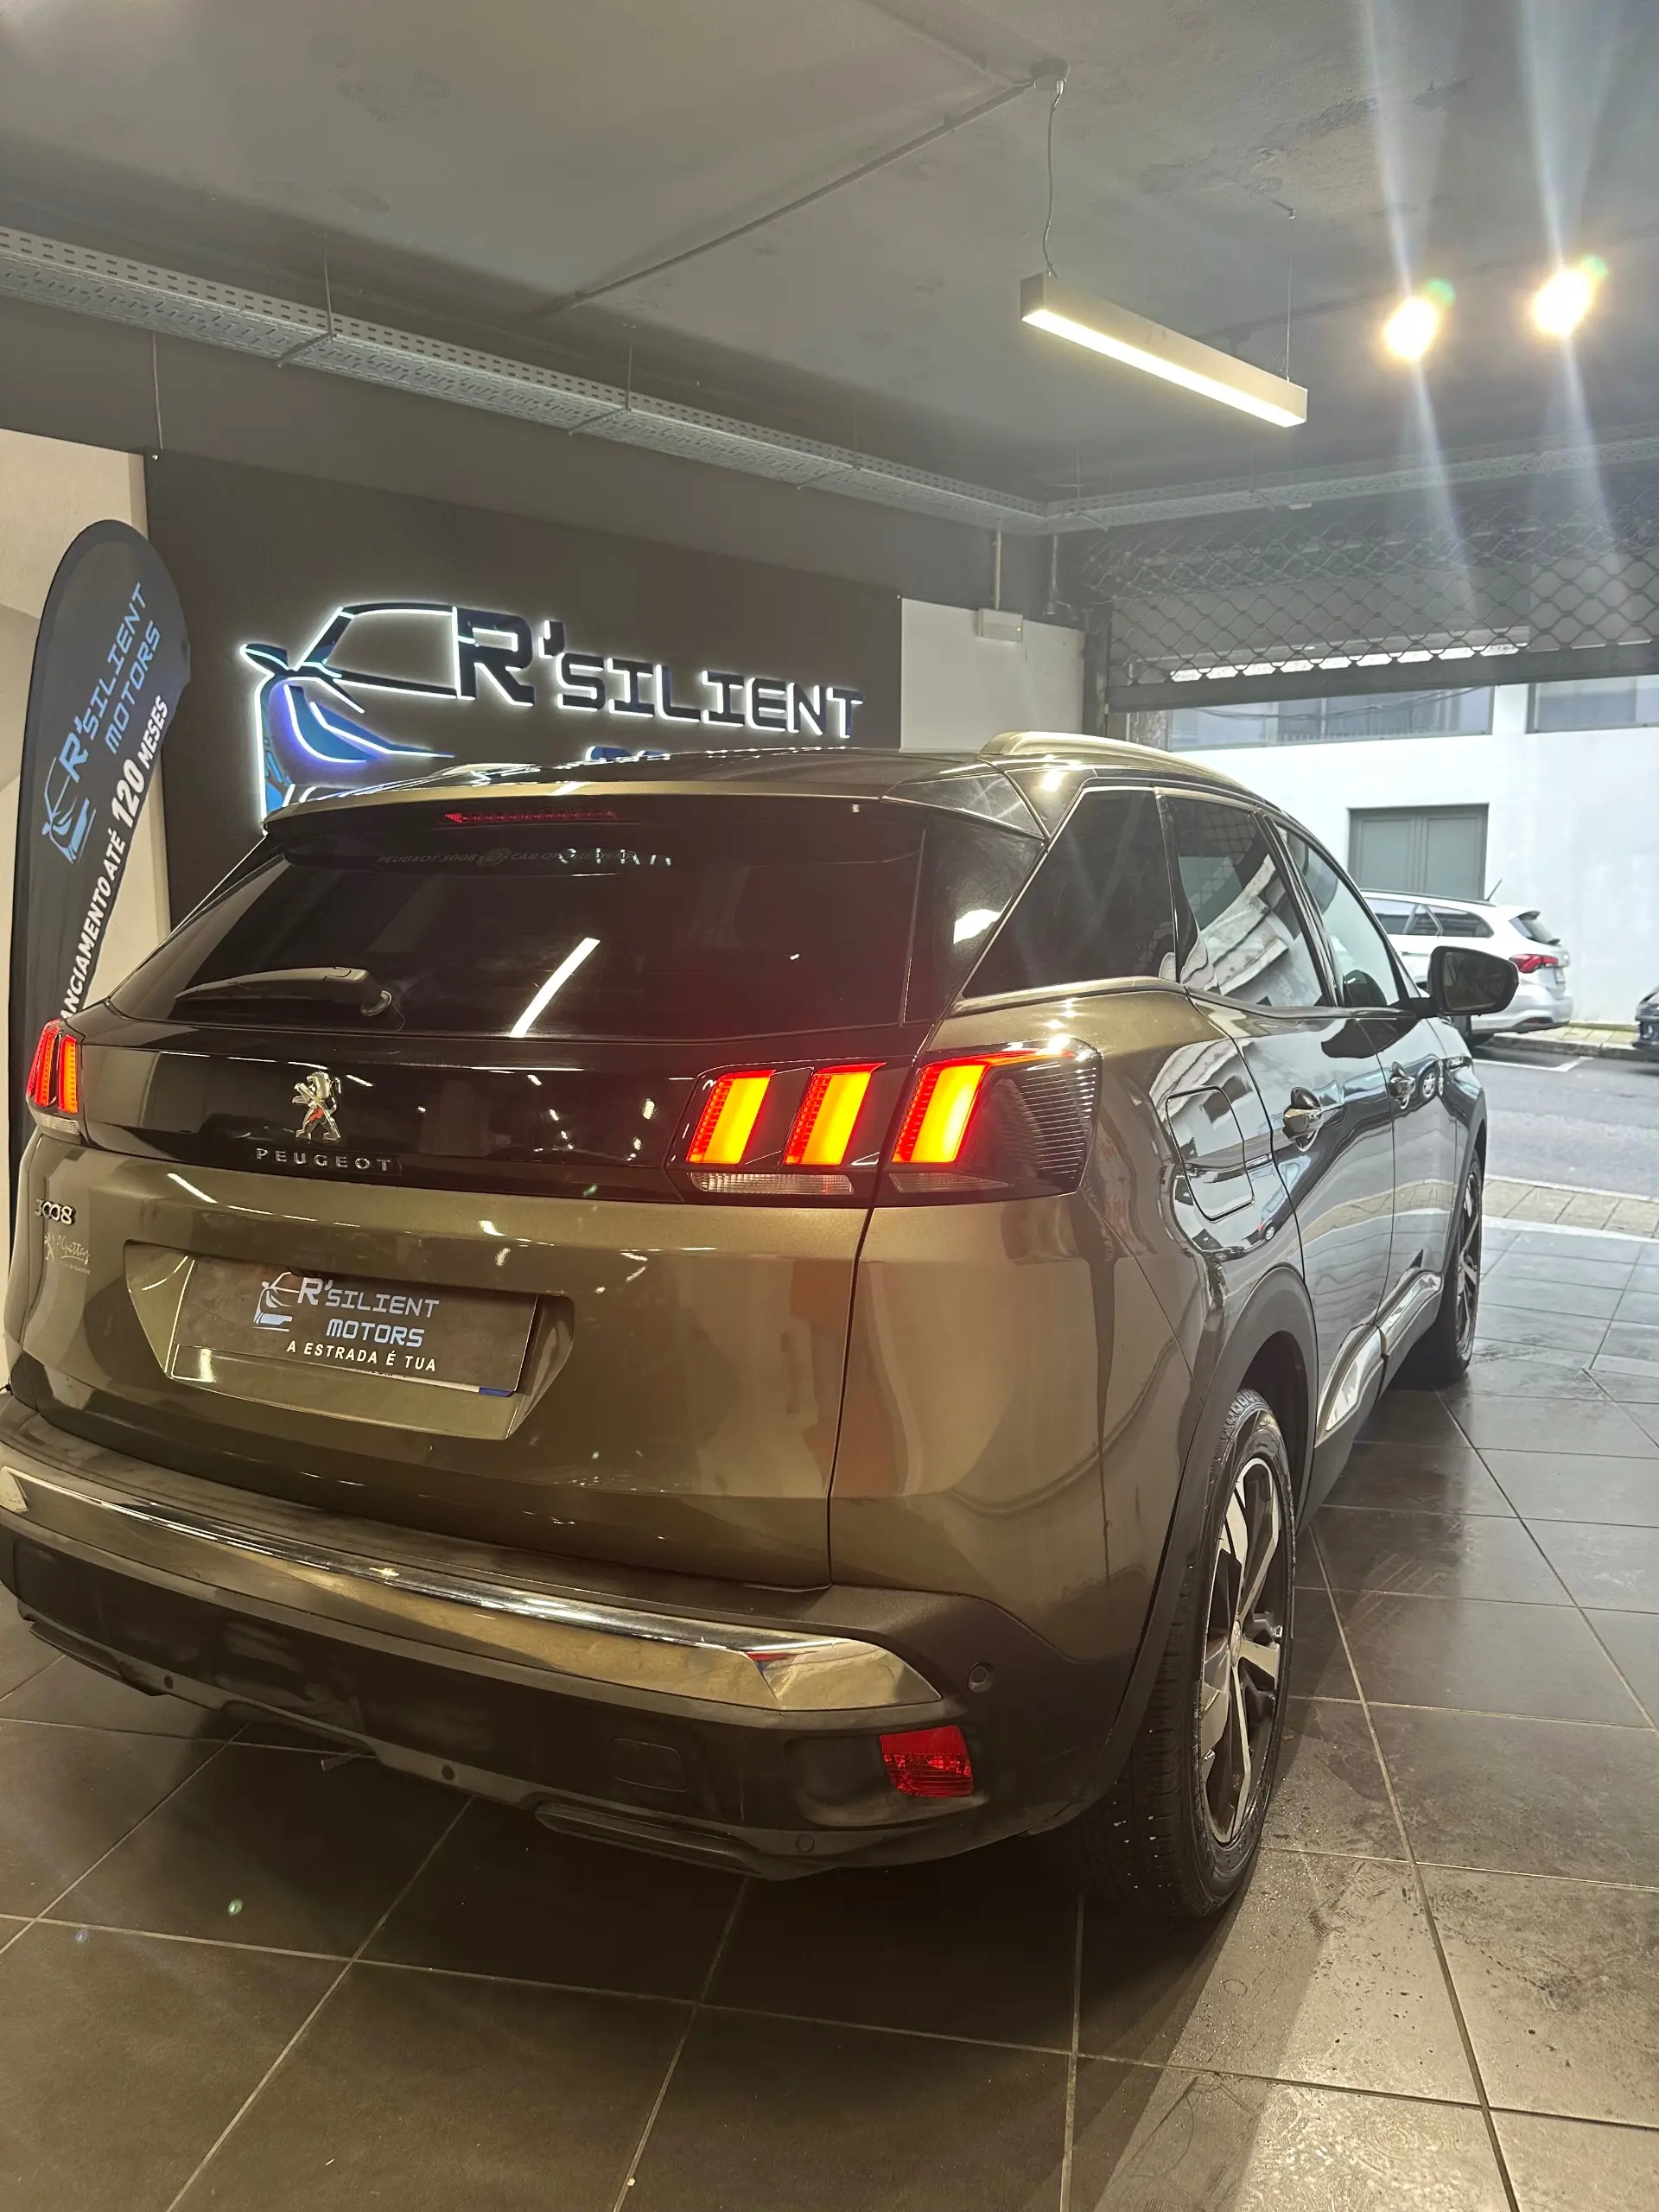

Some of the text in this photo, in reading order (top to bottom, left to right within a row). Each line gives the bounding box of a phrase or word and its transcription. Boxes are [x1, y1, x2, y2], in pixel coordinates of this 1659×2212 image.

[60, 582, 146, 783] R'SILIENT
[105, 620, 161, 754] MOTORS
[452, 606, 863, 739] R'SILIENT
[137, 695, 168, 770] MESES
[111, 759, 145, 828] 120
[103, 828, 126, 881] ATÉ
[377, 854, 441, 863] PEUGEOT
[256, 1147, 391, 1172] PEUGEOT
[35, 1198, 75, 1225] 3008
[297, 1277, 440, 1318] R'SILIENT
[286, 1340, 296, 1353] A
[303, 1342, 378, 1364] ESTRADA
[385, 1350, 397, 1366] É
[404, 1355, 435, 1372] TUA
[326, 1318, 425, 1348] MOTORS
